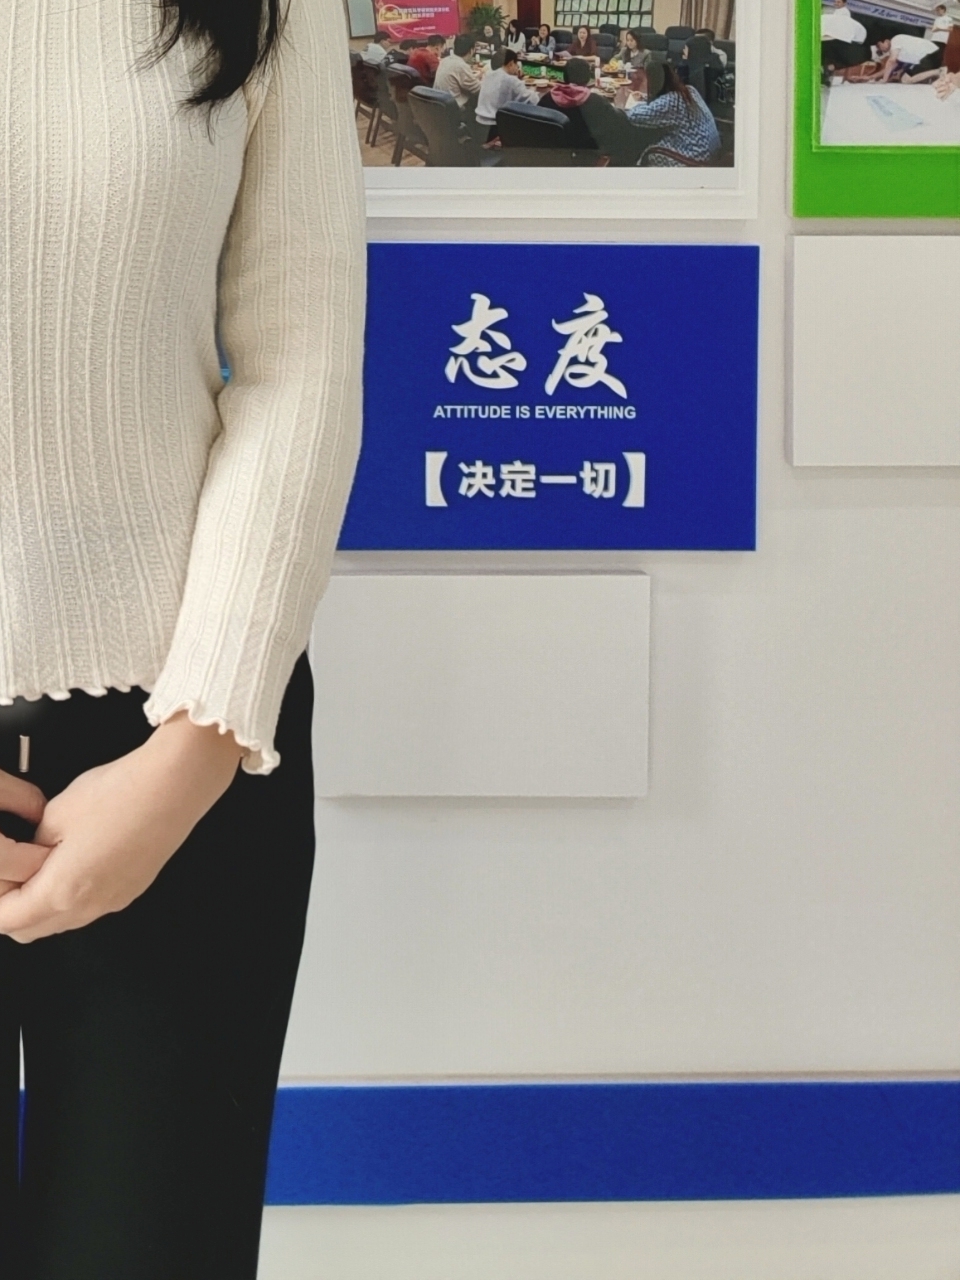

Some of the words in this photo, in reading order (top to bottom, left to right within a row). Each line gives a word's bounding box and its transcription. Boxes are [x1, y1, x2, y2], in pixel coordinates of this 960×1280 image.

[445, 292, 628, 399] 态度
[433, 405, 511, 419] ATTITUDE
[515, 405, 531, 419] IS
[535, 405, 637, 420] EVERYTHING
[425, 451, 646, 508] 【决定一切】
